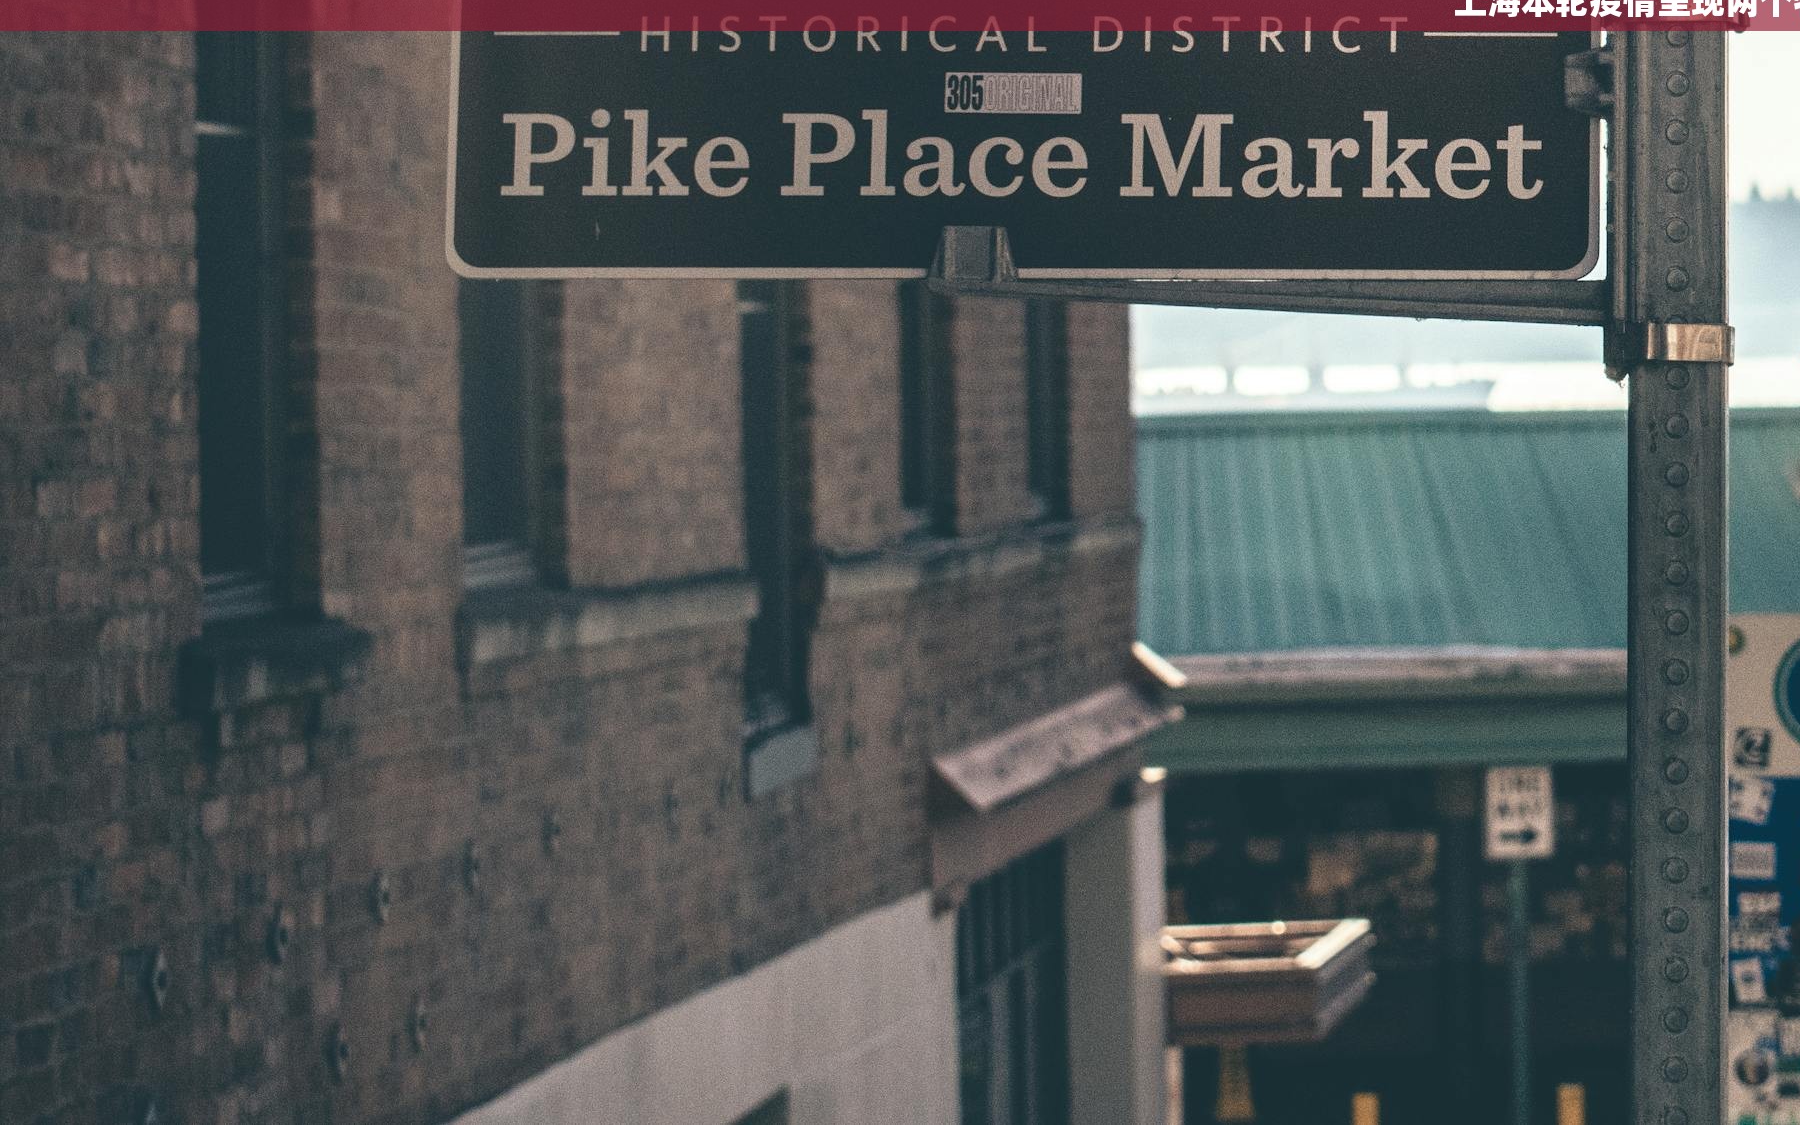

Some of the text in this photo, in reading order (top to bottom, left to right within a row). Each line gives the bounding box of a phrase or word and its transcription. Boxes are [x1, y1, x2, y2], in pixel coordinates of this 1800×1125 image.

[640, 15, 1409, 54] HISTORICAL DISTRICT
[500, 109, 1545, 200] Pike Place Market
